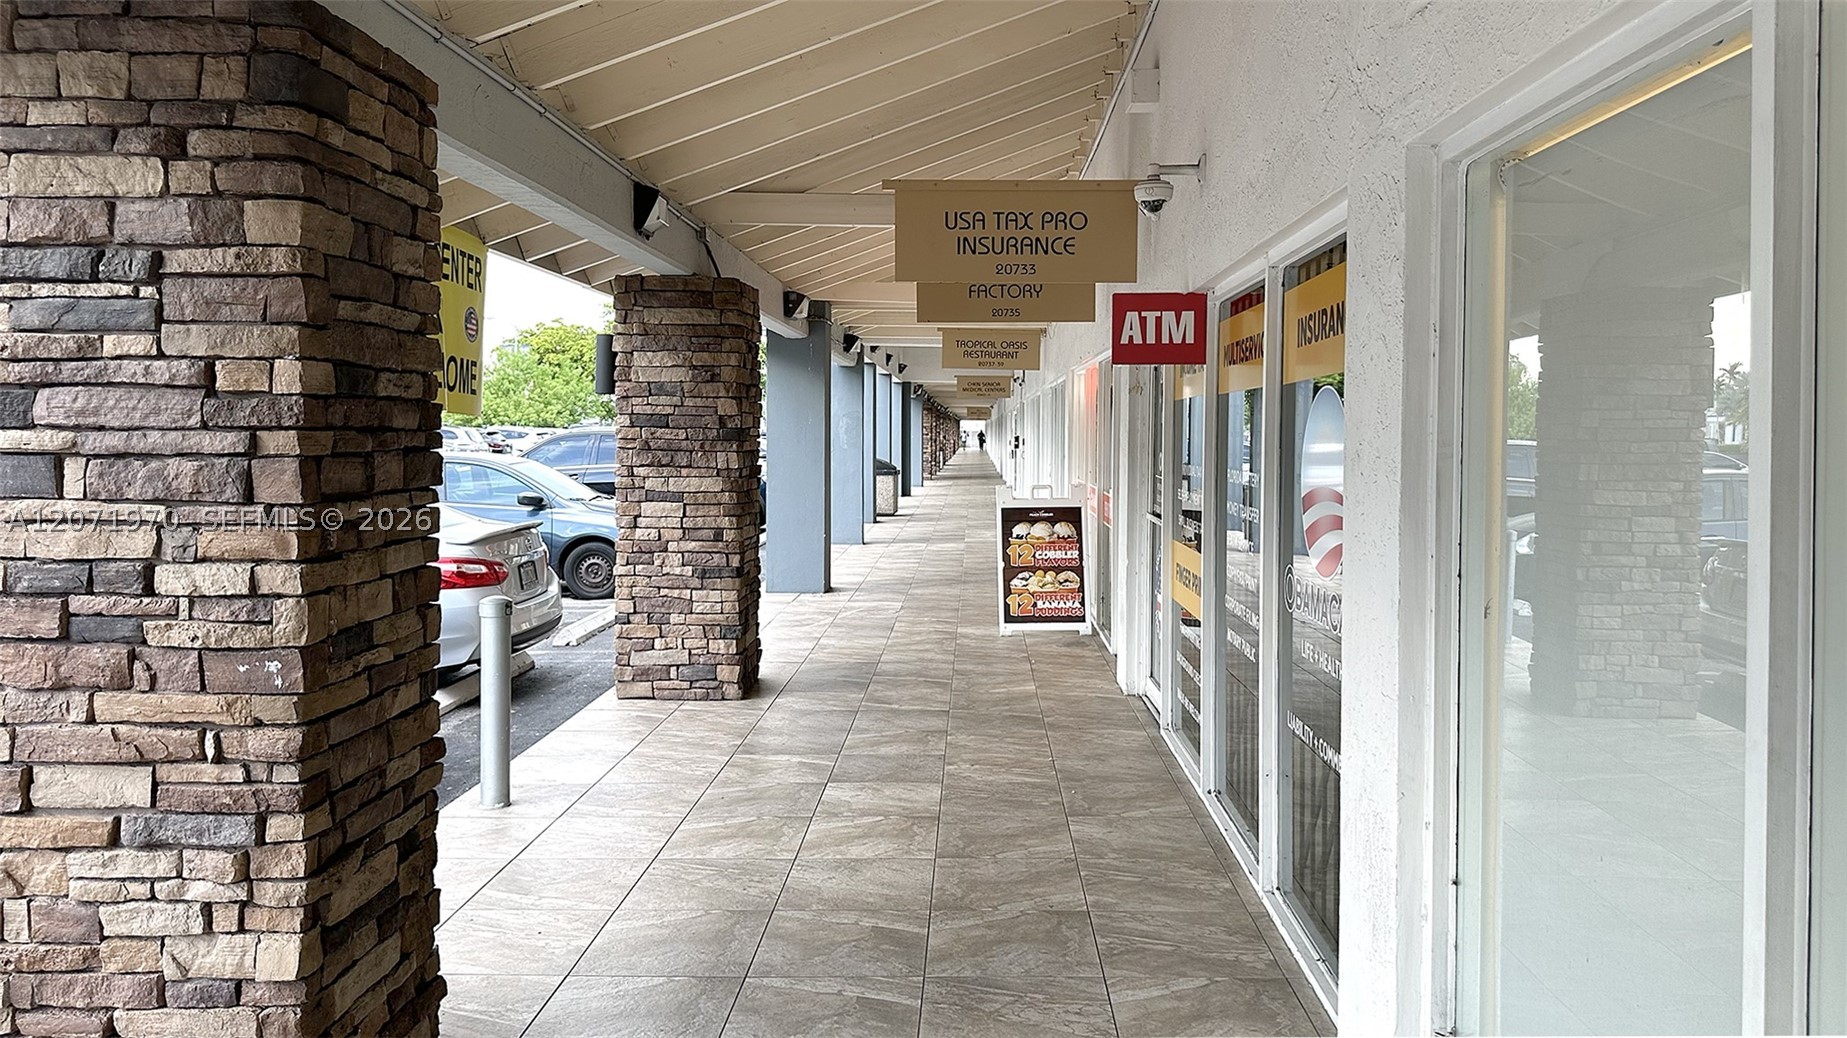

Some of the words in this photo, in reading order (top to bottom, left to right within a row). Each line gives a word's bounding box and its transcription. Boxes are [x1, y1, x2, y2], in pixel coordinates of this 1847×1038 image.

[944, 211, 986, 230] USA
[992, 211, 1034, 230] TAX
[1041, 211, 1088, 231] PRO
[957, 236, 1076, 255] INSURANCE
[995, 263, 1036, 275] 20733
[968, 283, 1043, 298] FACTORY
[991, 308, 1021, 317] 20735
[1120, 311, 1195, 345] ATM
[955, 340, 997, 349] TROPICAL
[1000, 341, 1028, 350] OASIS
[963, 350, 1019, 359] RESTAURANT
[1034, 543, 1079, 552] DIFFERENT
[1006, 544, 1034, 567] 12
[1035, 551, 1079, 559] COBBLER
[1034, 593, 1082, 601] DIFFERENT
[1006, 594, 1034, 616] 12
[1036, 600, 1081, 608] BANANA
[1034, 607, 1084, 616] PUDDINGS
